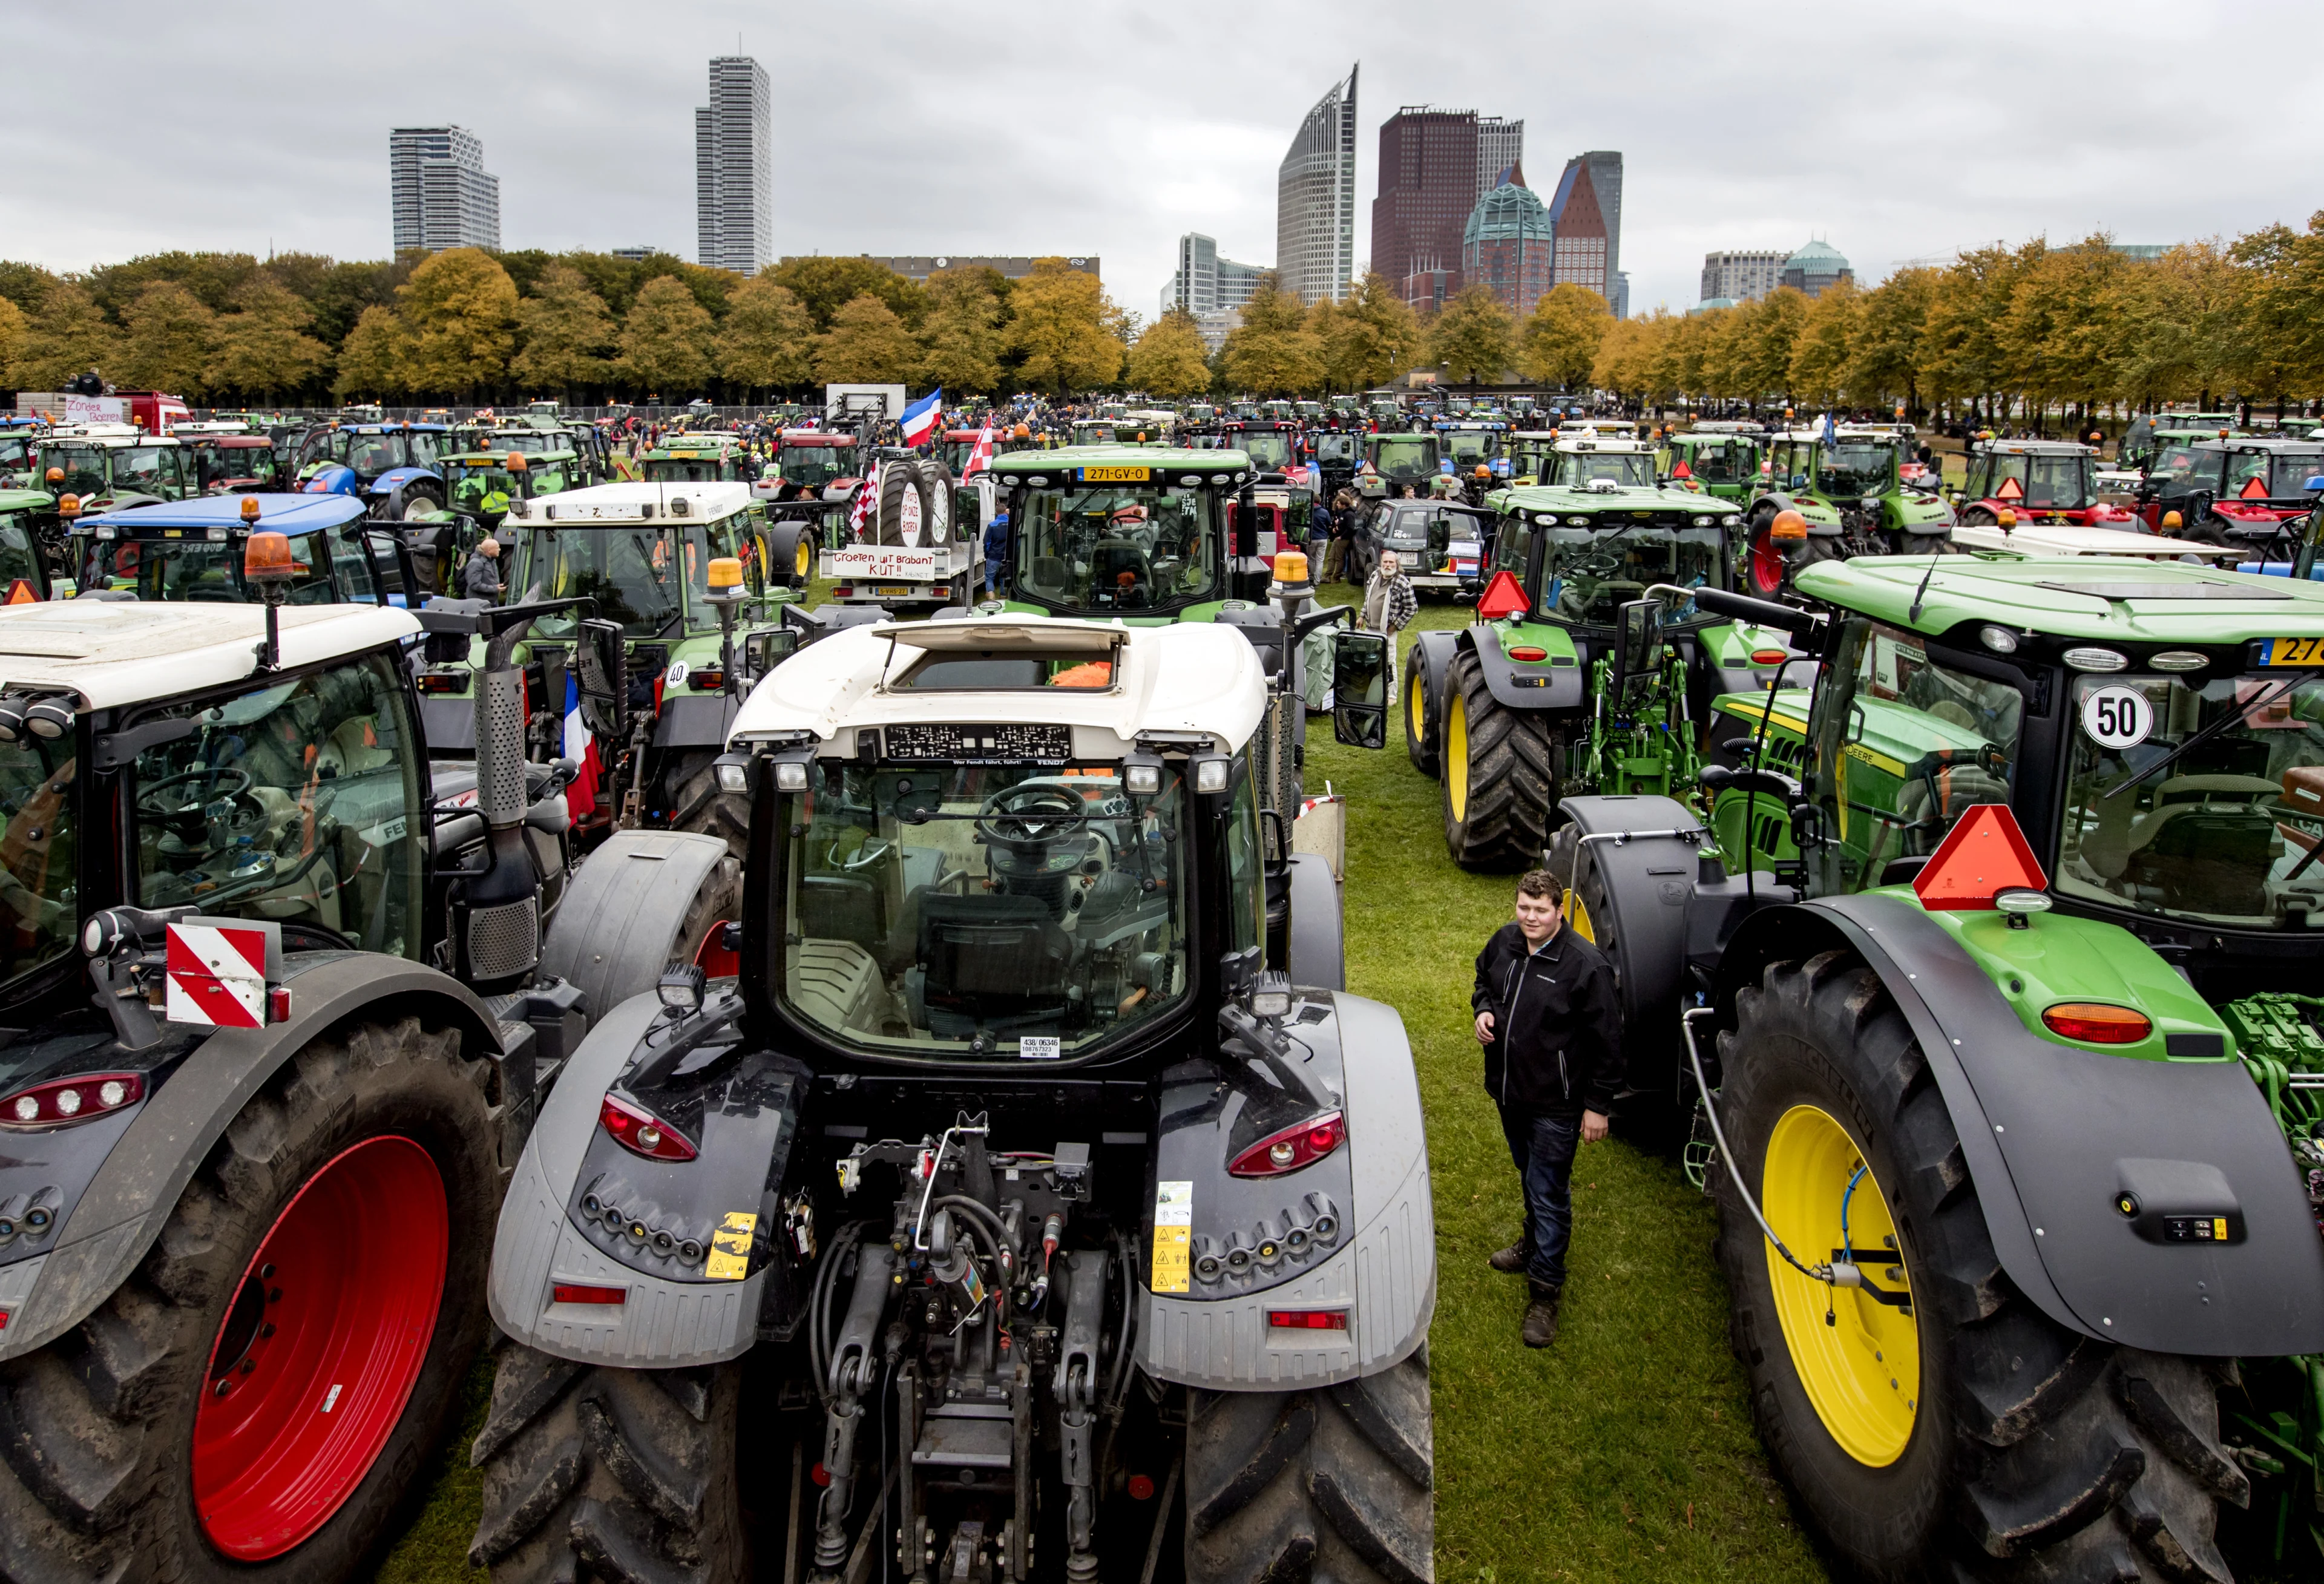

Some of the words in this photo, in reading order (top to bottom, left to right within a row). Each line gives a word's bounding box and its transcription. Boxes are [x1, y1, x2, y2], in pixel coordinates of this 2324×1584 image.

[905, 491, 917, 504] TROTS
[707, 504, 723, 516] FENDT
[902, 504, 907, 515] OP
[908, 506, 918, 517] ONZE
[902, 521, 917, 533] BOEREN
[670, 665, 684, 683] 40
[2098, 697, 2136, 737] 50
[1847, 744, 1874, 764] DEERE
